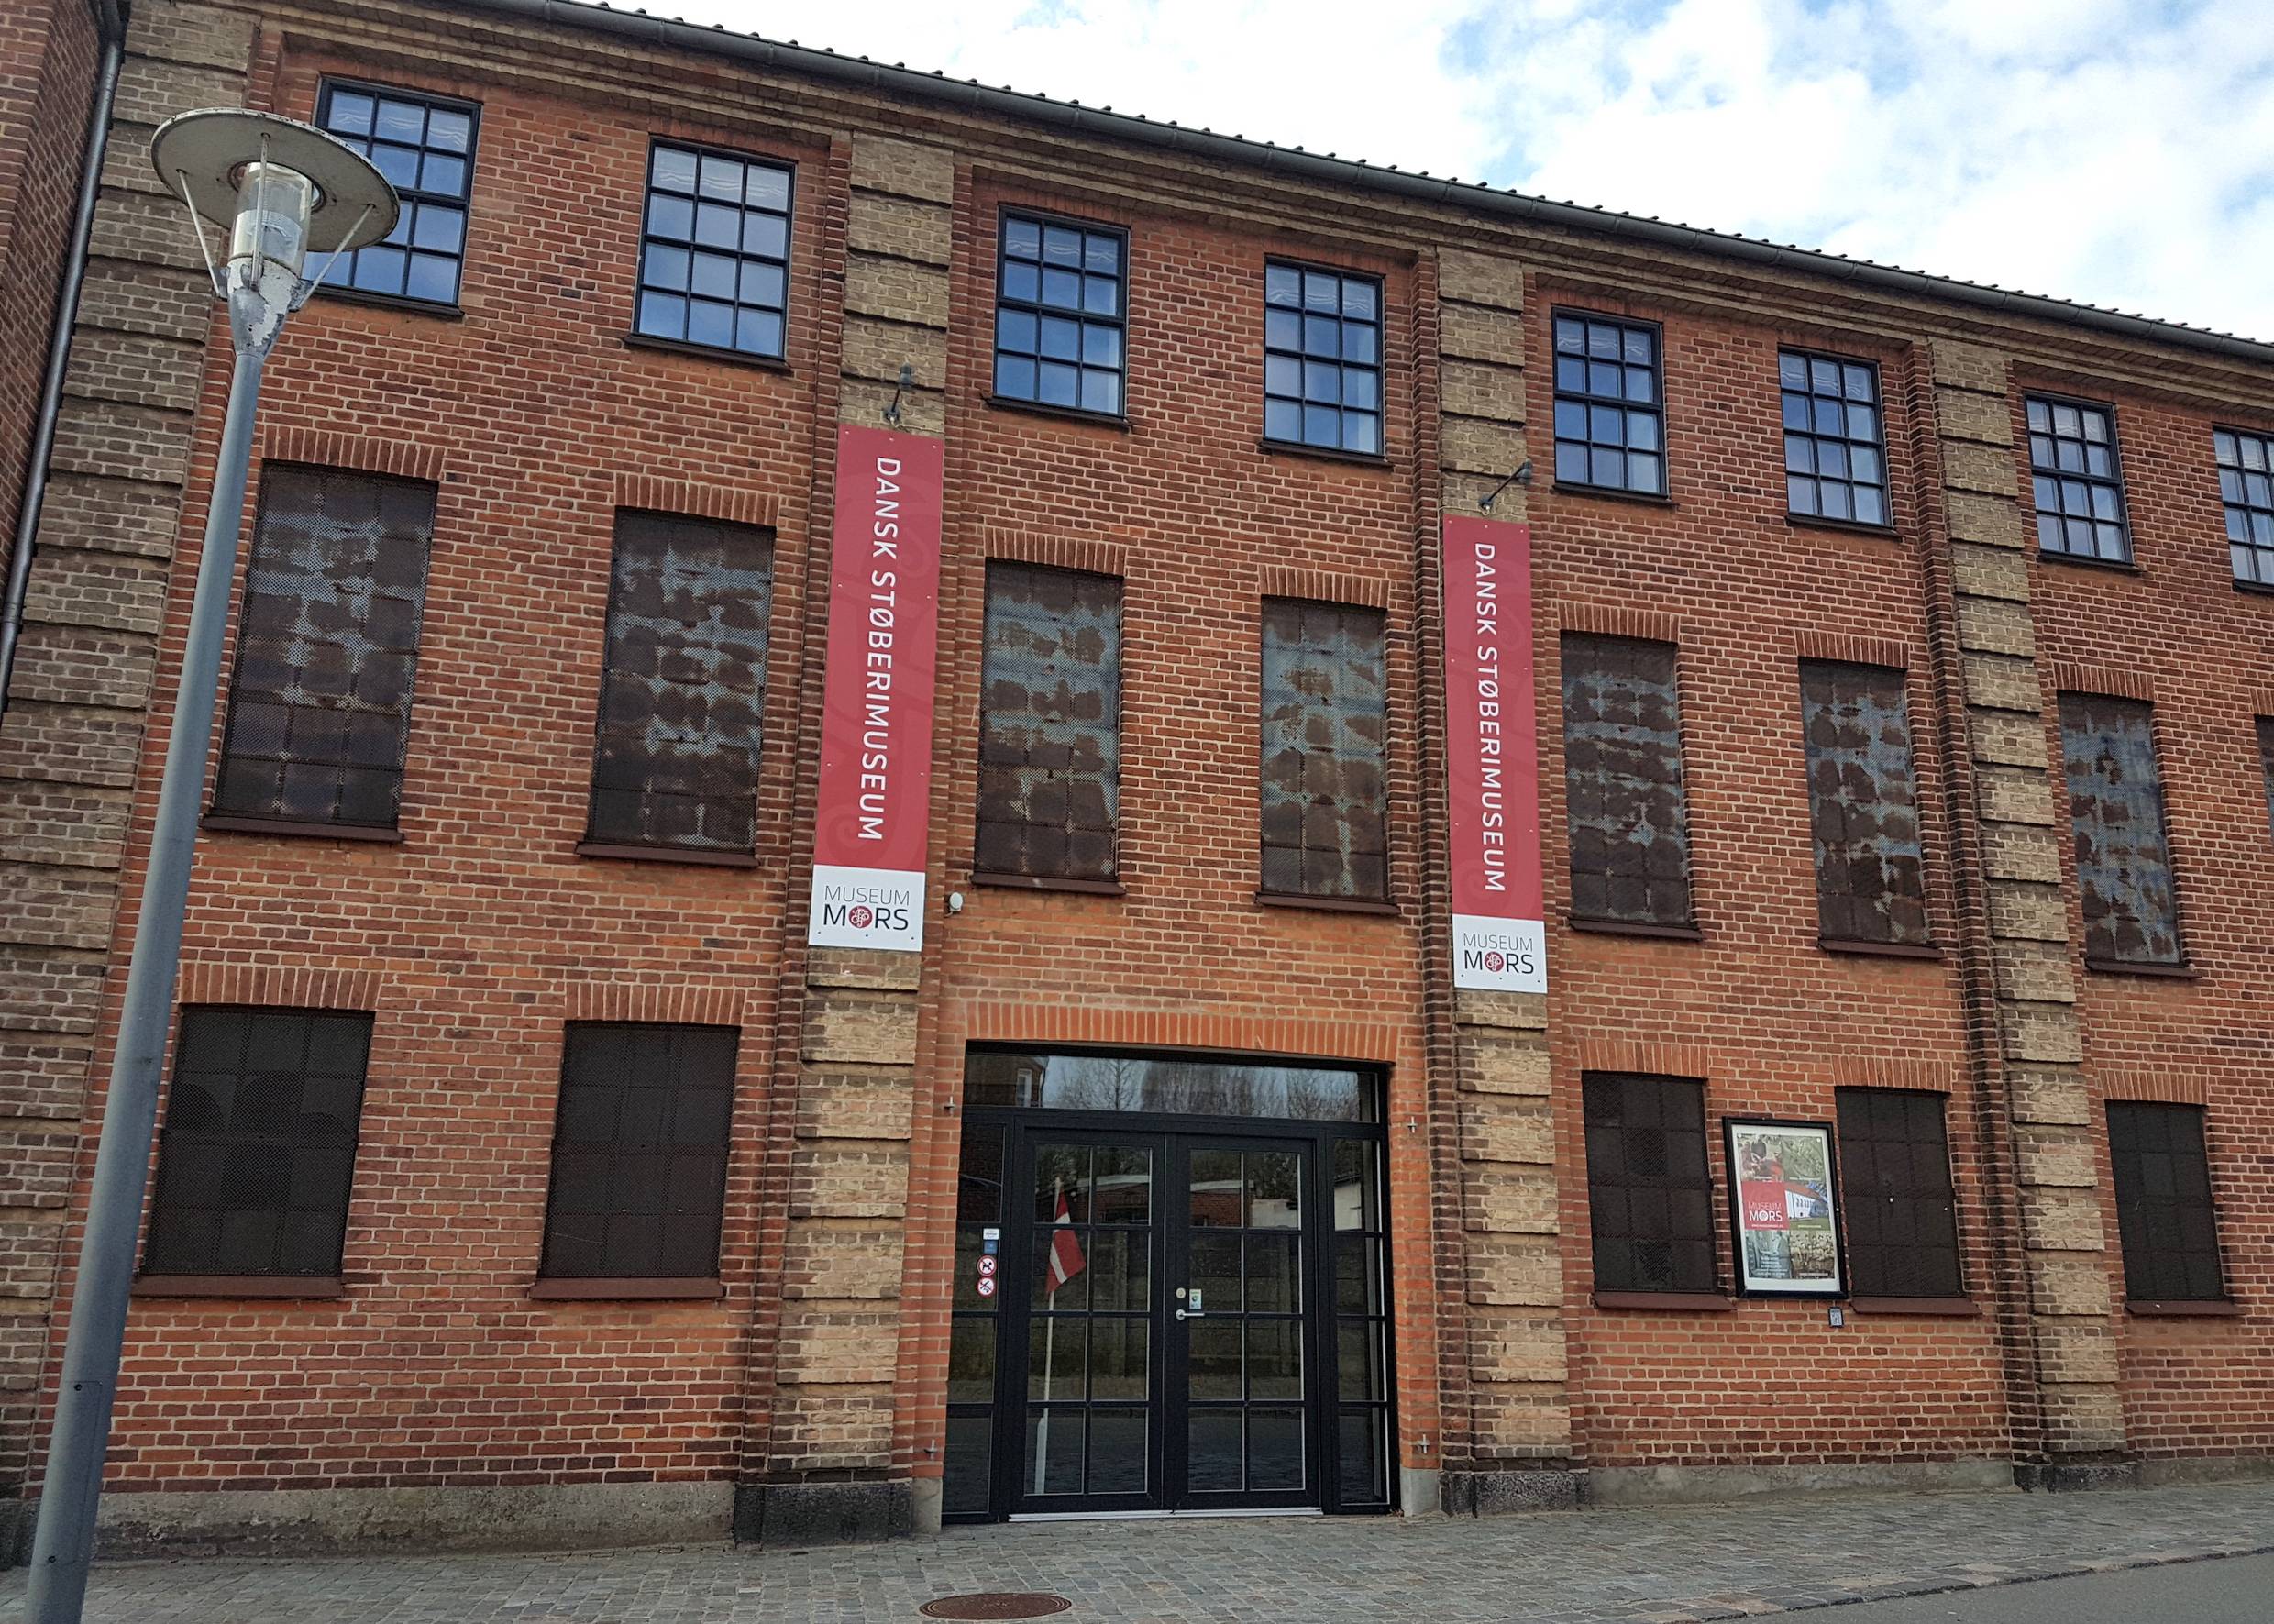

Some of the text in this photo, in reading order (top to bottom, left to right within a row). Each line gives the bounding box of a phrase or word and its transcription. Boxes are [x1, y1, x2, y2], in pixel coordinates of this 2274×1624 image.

[859, 457, 900, 840] DANSK STØBERIMUSEUM
[1474, 543, 1506, 891] DANSK STØBERIMUSEUM
[824, 885, 910, 906] MUSEUM
[823, 903, 909, 931] MORS
[1463, 932, 1533, 952] MUSEUM
[1463, 949, 1535, 975] MORS
[1748, 1201, 1782, 1210] MUSEUM
[1749, 1210, 1783, 1222] MORS
